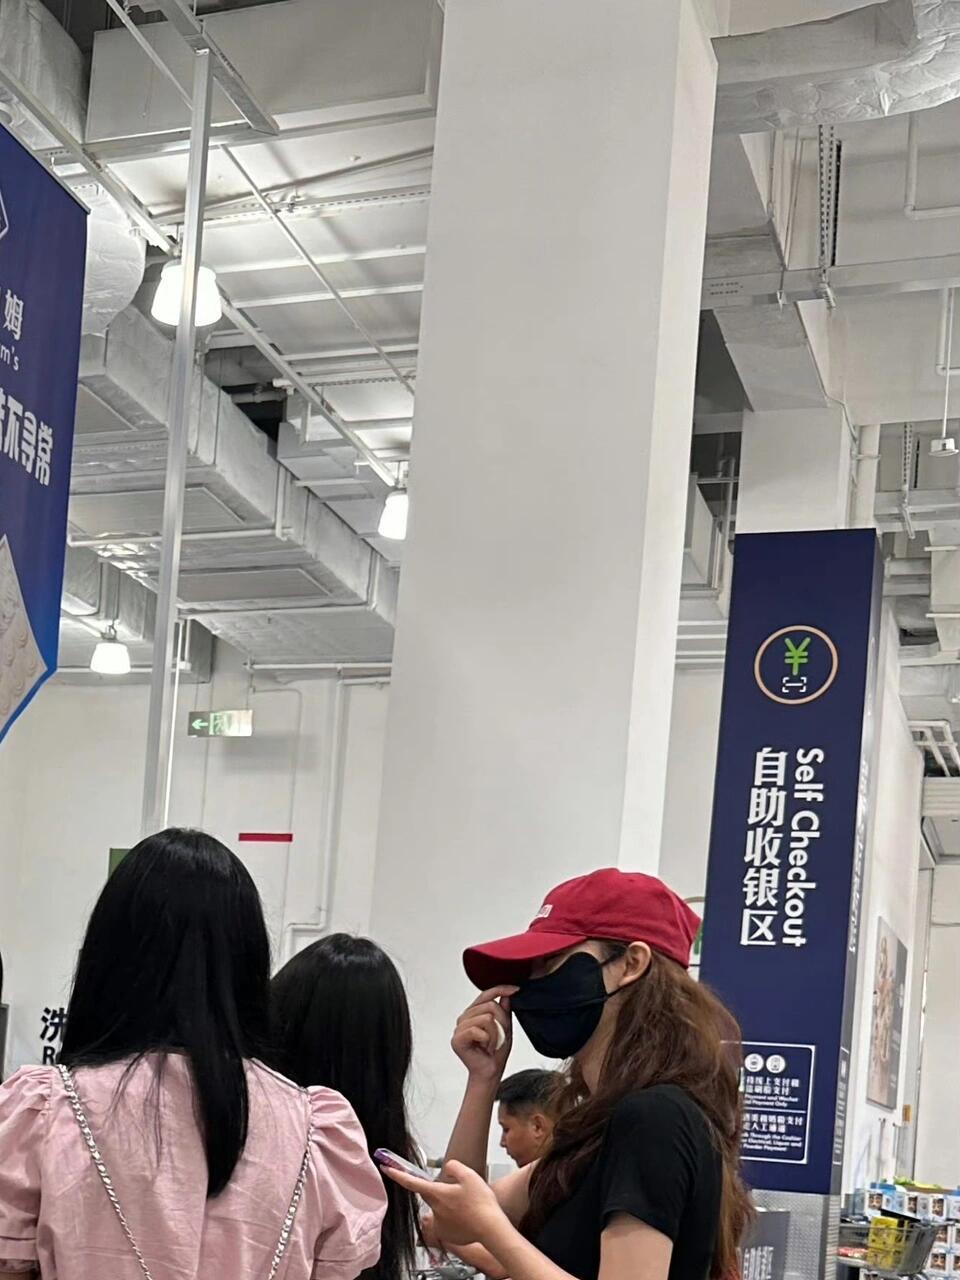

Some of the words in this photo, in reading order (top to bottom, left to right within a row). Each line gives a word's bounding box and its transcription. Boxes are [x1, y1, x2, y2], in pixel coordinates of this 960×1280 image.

[794, 748, 824, 802] Self
[740, 747, 788, 946] 自助收银区
[782, 810, 820, 947] Checkout
